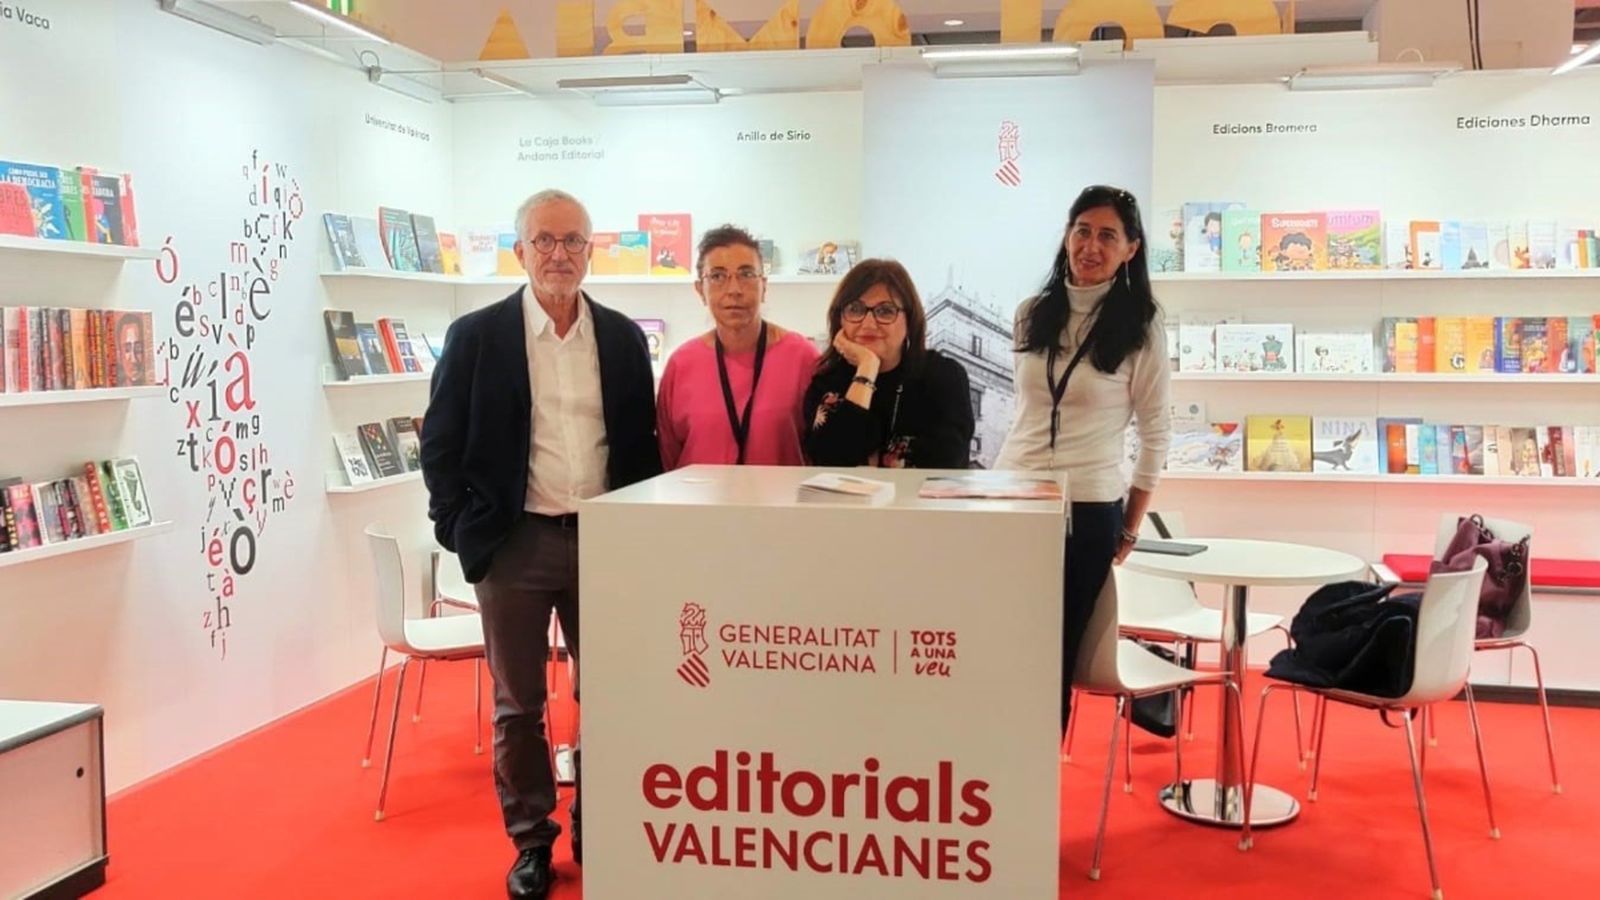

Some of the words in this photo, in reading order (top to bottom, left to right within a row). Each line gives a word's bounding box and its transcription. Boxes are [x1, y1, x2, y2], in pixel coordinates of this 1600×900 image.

[15, 6, 50, 30] Vaca
[1212, 123, 1263, 135] Edicions
[1265, 122, 1318, 134] Bromera
[1456, 116, 1527, 130] Ediciones
[1530, 113, 1592, 127] Dharma
[737, 131, 767, 141] Anillo
[769, 130, 784, 141] de
[786, 130, 811, 141] Sirio
[249, 184, 257, 206] d
[244, 219, 252, 238] b
[282, 211, 293, 240] k
[231, 242, 247, 264] m
[280, 244, 287, 259] n
[230, 275, 240, 291] n
[249, 257, 271, 321] è
[175, 286, 195, 337] é
[235, 303, 244, 325] d
[212, 324, 222, 345] v
[247, 324, 255, 349] p
[169, 337, 180, 360] b
[225, 333, 257, 412] à
[186, 400, 200, 429] x
[236, 421, 249, 440] m
[176, 439, 186, 456] z
[187, 432, 199, 472] t
[214, 420, 236, 475] ó
[239, 454, 248, 471] s
[243, 478, 256, 514] ç
[261, 468, 272, 504] r
[273, 497, 285, 513] m
[208, 527, 223, 567] é
[229, 508, 256, 575] ò
[222, 568, 234, 597] à
[216, 596, 231, 630] h
[719, 624, 880, 648] GENERALITAT
[910, 630, 957, 646] TOTS
[721, 649, 877, 674] VALENCIANA
[910, 648, 921, 659] A
[924, 648, 957, 660] UNA
[915, 661, 952, 678] veu
[642, 750, 993, 827] editorials
[643, 821, 993, 883] VALENCIANES
